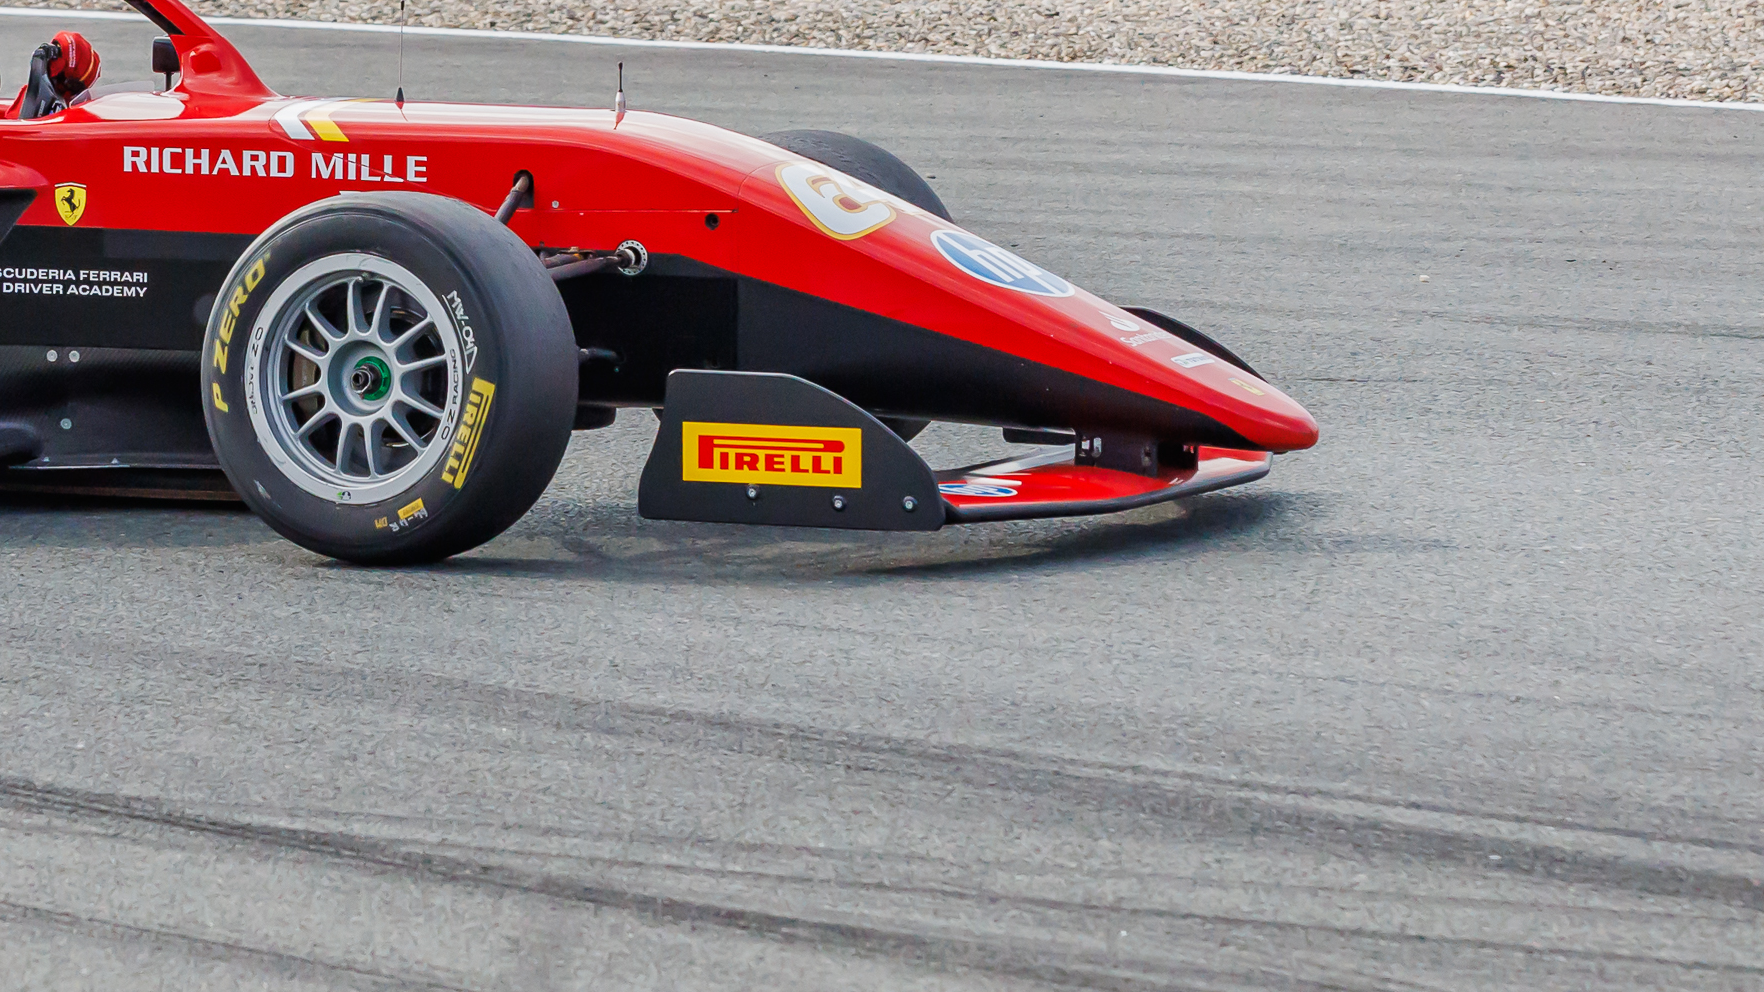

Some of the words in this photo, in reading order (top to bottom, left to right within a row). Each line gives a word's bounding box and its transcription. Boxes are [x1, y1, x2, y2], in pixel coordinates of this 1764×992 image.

[122, 145, 296, 179] RICHARD
[310, 151, 428, 183] MILLE
[2, 282, 64, 296] DRIVER
[66, 283, 148, 298] ACADEMY
[79, 269, 149, 284] FERRARI
[213, 258, 266, 375] ZERO
[449, 348, 459, 405] RACING
[441, 376, 496, 489] PIRELLI
[698, 434, 845, 475] PIRELLI
